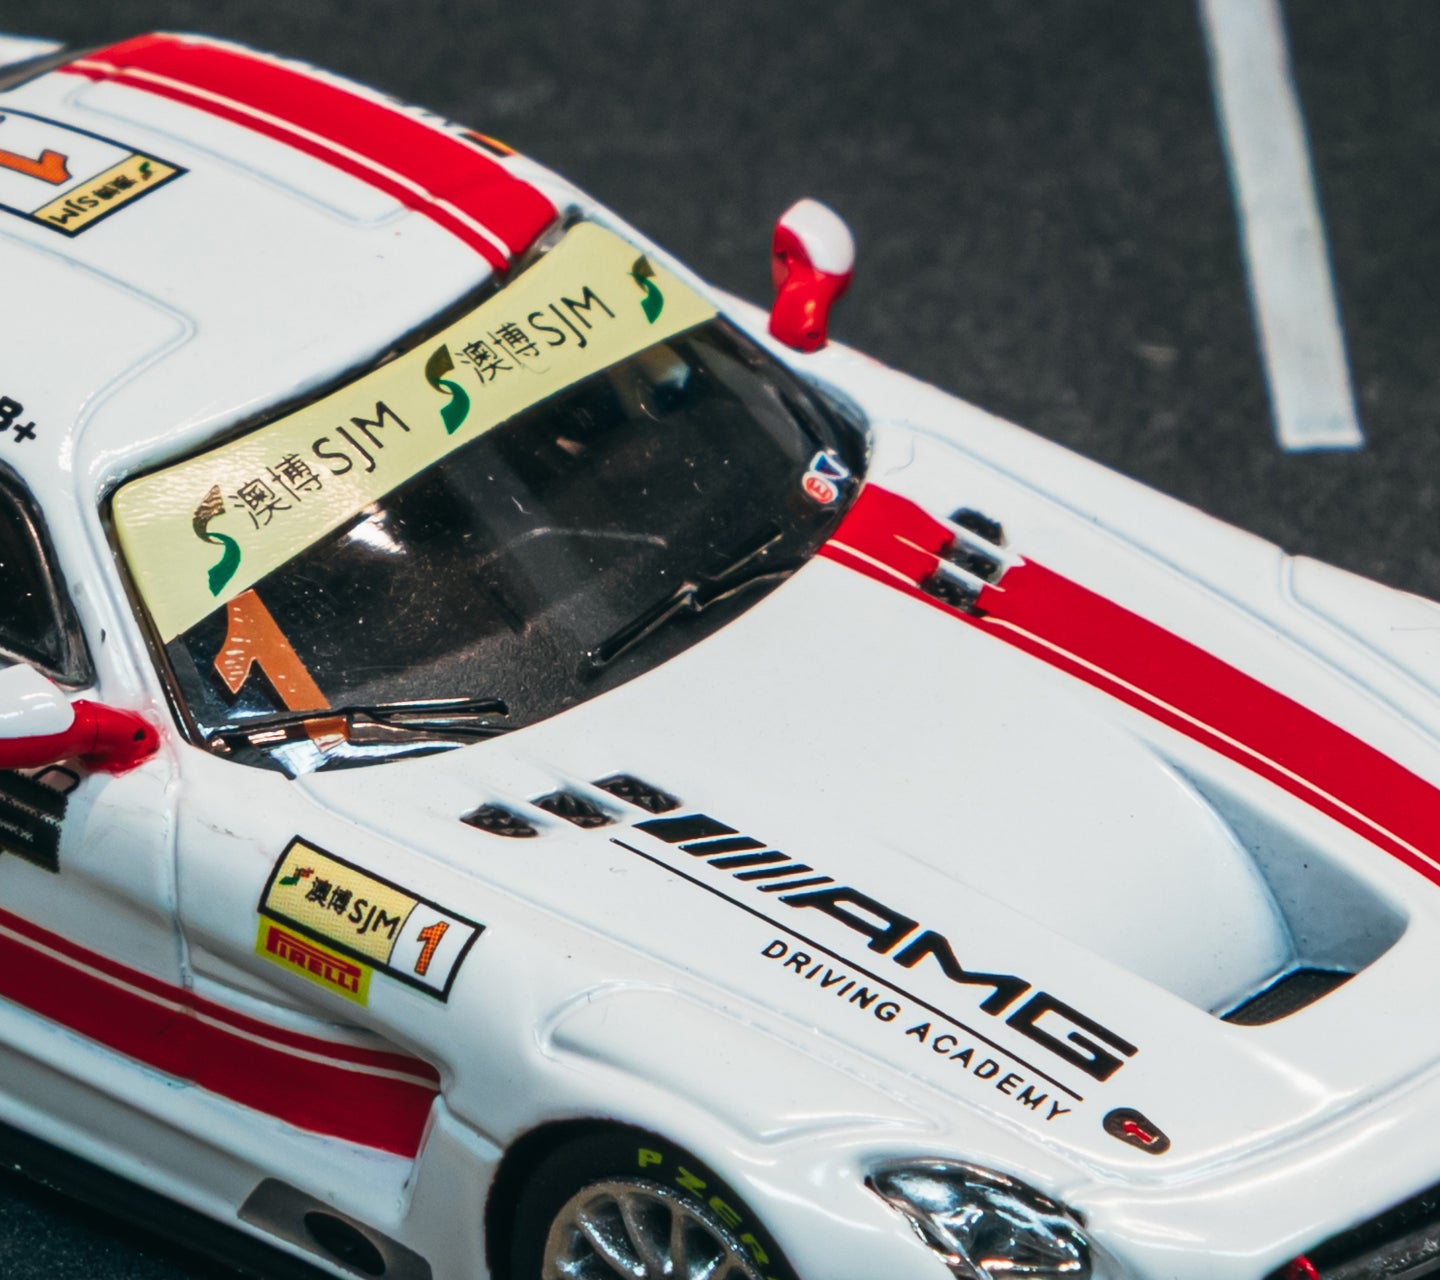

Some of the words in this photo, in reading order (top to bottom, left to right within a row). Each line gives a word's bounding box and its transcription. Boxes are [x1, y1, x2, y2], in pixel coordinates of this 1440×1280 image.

[266, 924, 362, 994] PIRELLI
[414, 920, 450, 976] 1
[779, 886, 1139, 1083] AMG
[760, 939, 901, 1024] DRIVING
[905, 1021, 1072, 1122] ACADEMY
